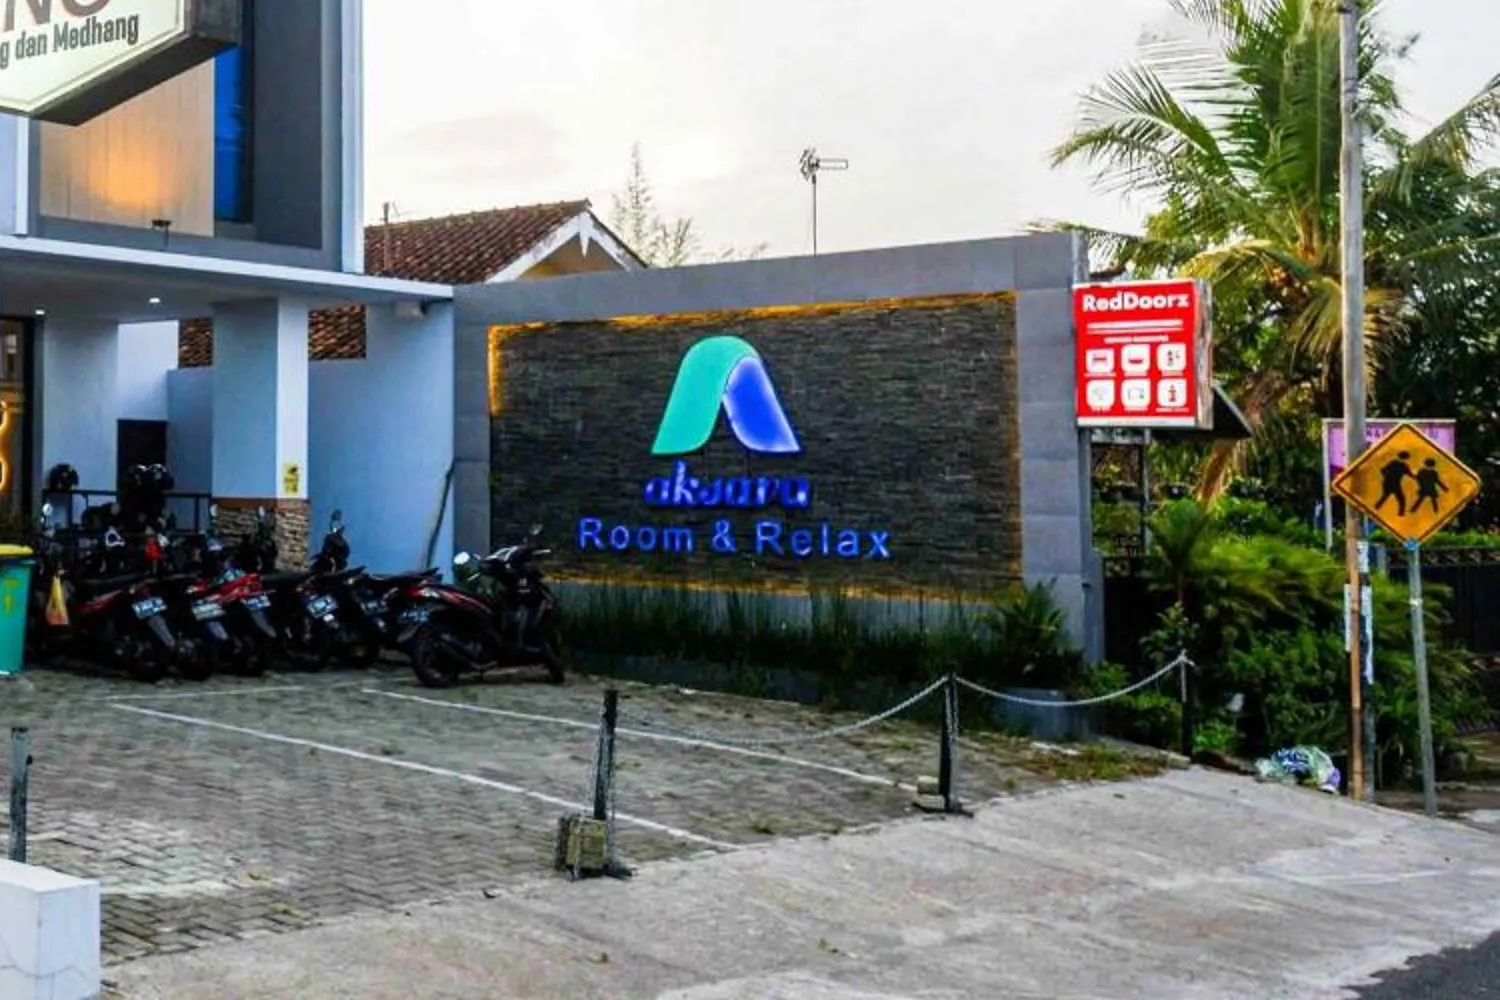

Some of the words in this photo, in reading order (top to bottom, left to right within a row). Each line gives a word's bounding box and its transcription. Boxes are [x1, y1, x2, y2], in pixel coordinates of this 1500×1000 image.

[15, 30, 49, 61] dan
[1082, 291, 1189, 312] RedDoorz
[579, 517, 694, 551] Room
[711, 519, 738, 554] &
[755, 519, 892, 558] Relax
